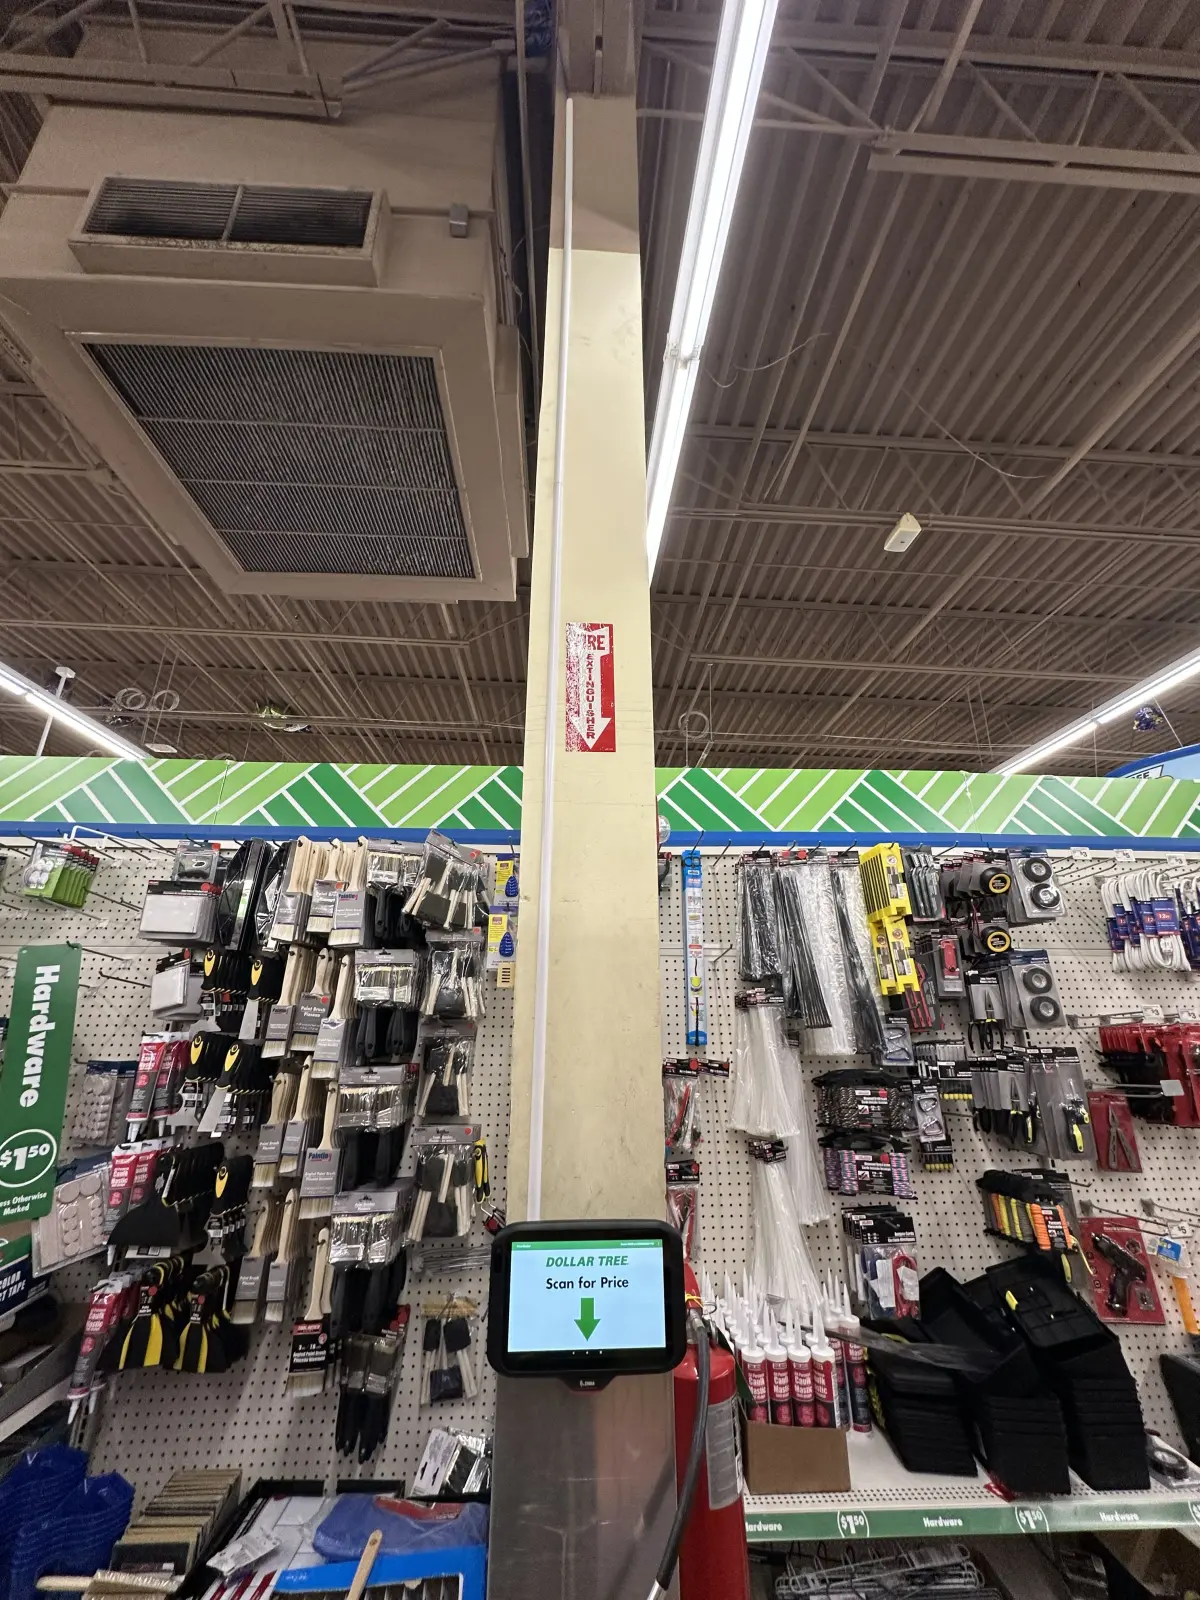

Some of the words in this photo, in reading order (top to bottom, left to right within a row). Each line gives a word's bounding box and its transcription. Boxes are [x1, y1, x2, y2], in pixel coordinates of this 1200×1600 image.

[586, 653, 595, 739] EXTINGUISHER
[20, 965, 60, 1107] Hardware
[12, 1191, 47, 1205] Otherwise
[3, 1202, 30, 1216] Marked
[546, 1256, 595, 1267] DOLLAR
[598, 1255, 629, 1266] TREE
[545, 1278, 574, 1289] Scan
[578, 1276, 596, 1288] for
[600, 1276, 629, 1288] Price
[1100, 1509, 1140, 1522] Hardware
[922, 1517, 963, 1528] Hardware
